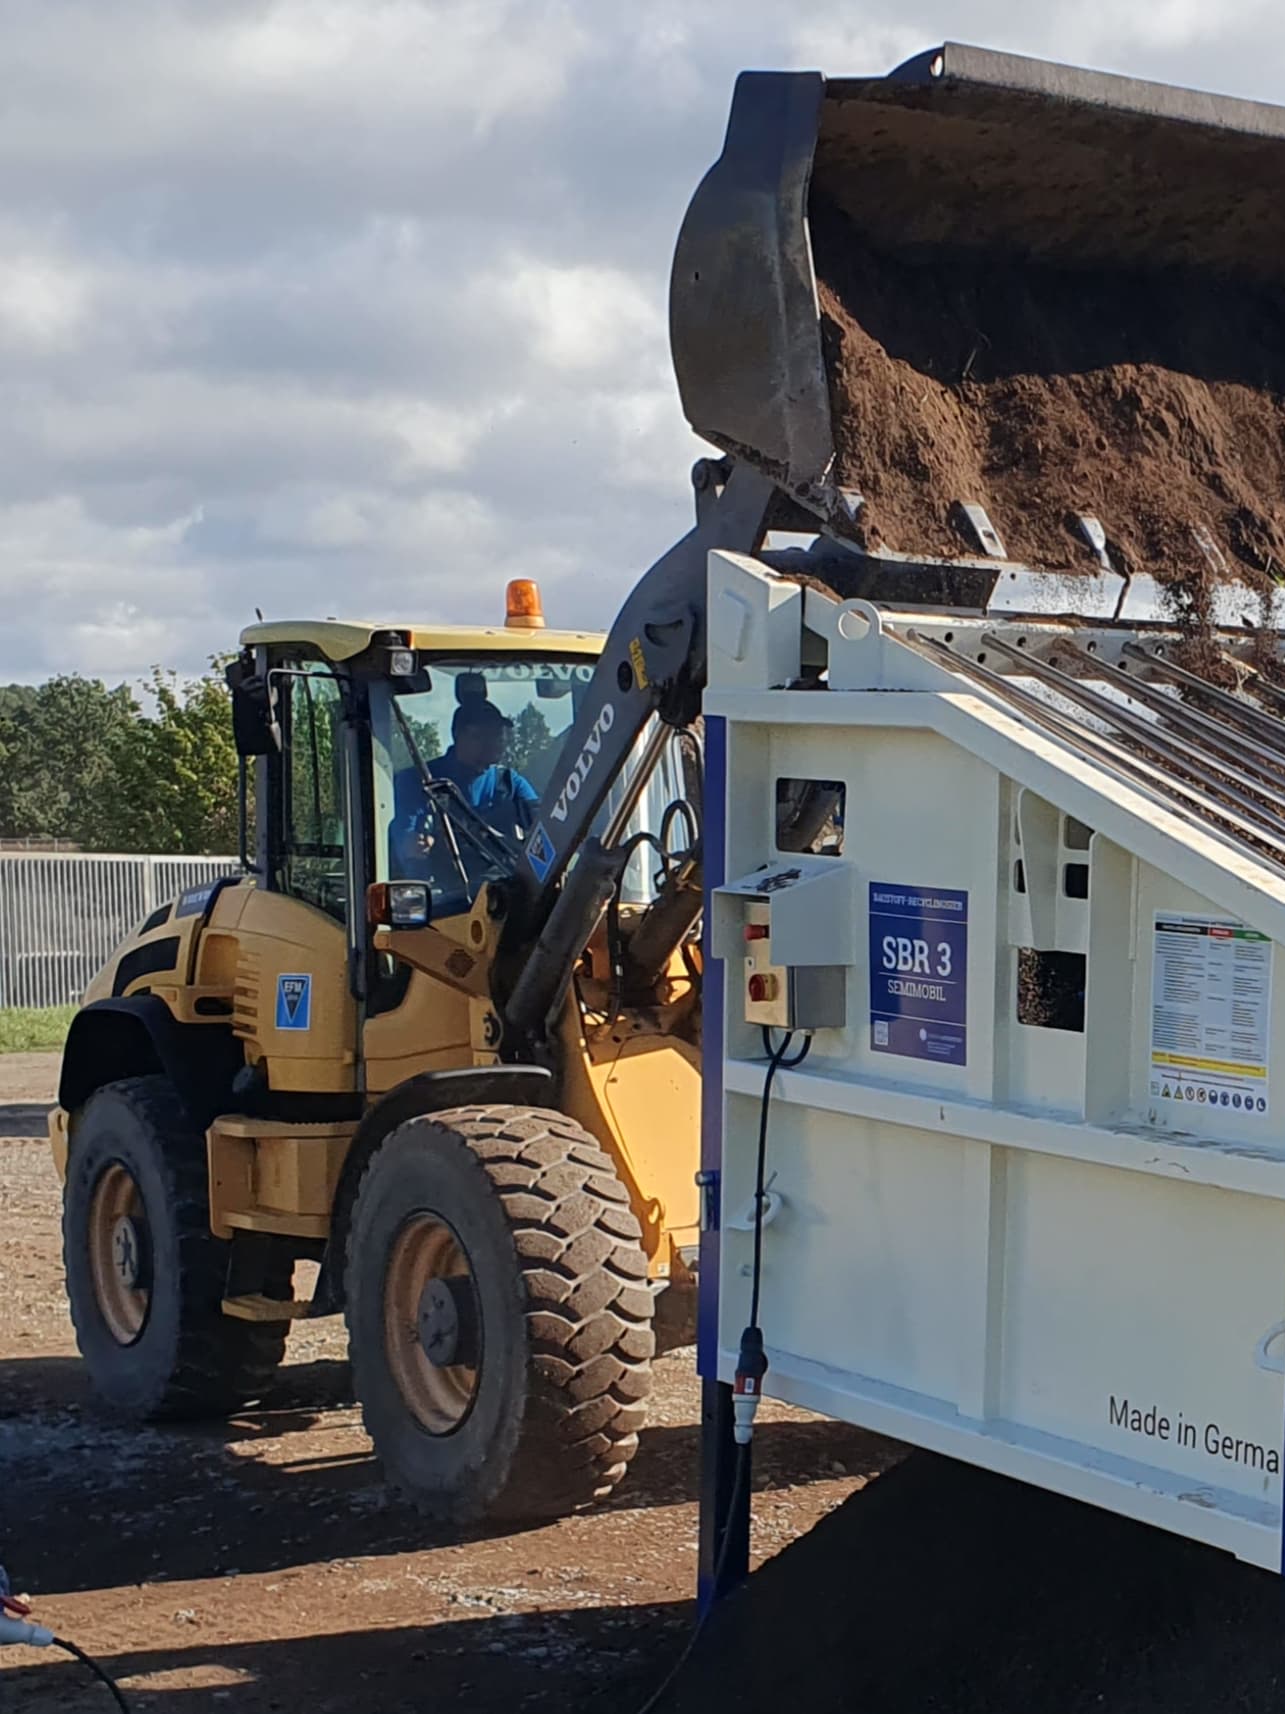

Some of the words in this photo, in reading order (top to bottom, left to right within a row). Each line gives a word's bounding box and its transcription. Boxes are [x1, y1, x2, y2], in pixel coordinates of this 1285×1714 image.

[482, 663, 596, 682] VOLVO
[551, 703, 615, 823] VOLVO
[882, 935, 930, 975] SBR
[936, 942, 952, 977] 3
[887, 979, 947, 1002] SEMIMOBIL
[1109, 1395, 1171, 1440] Made
[1177, 1412, 1197, 1449] in
